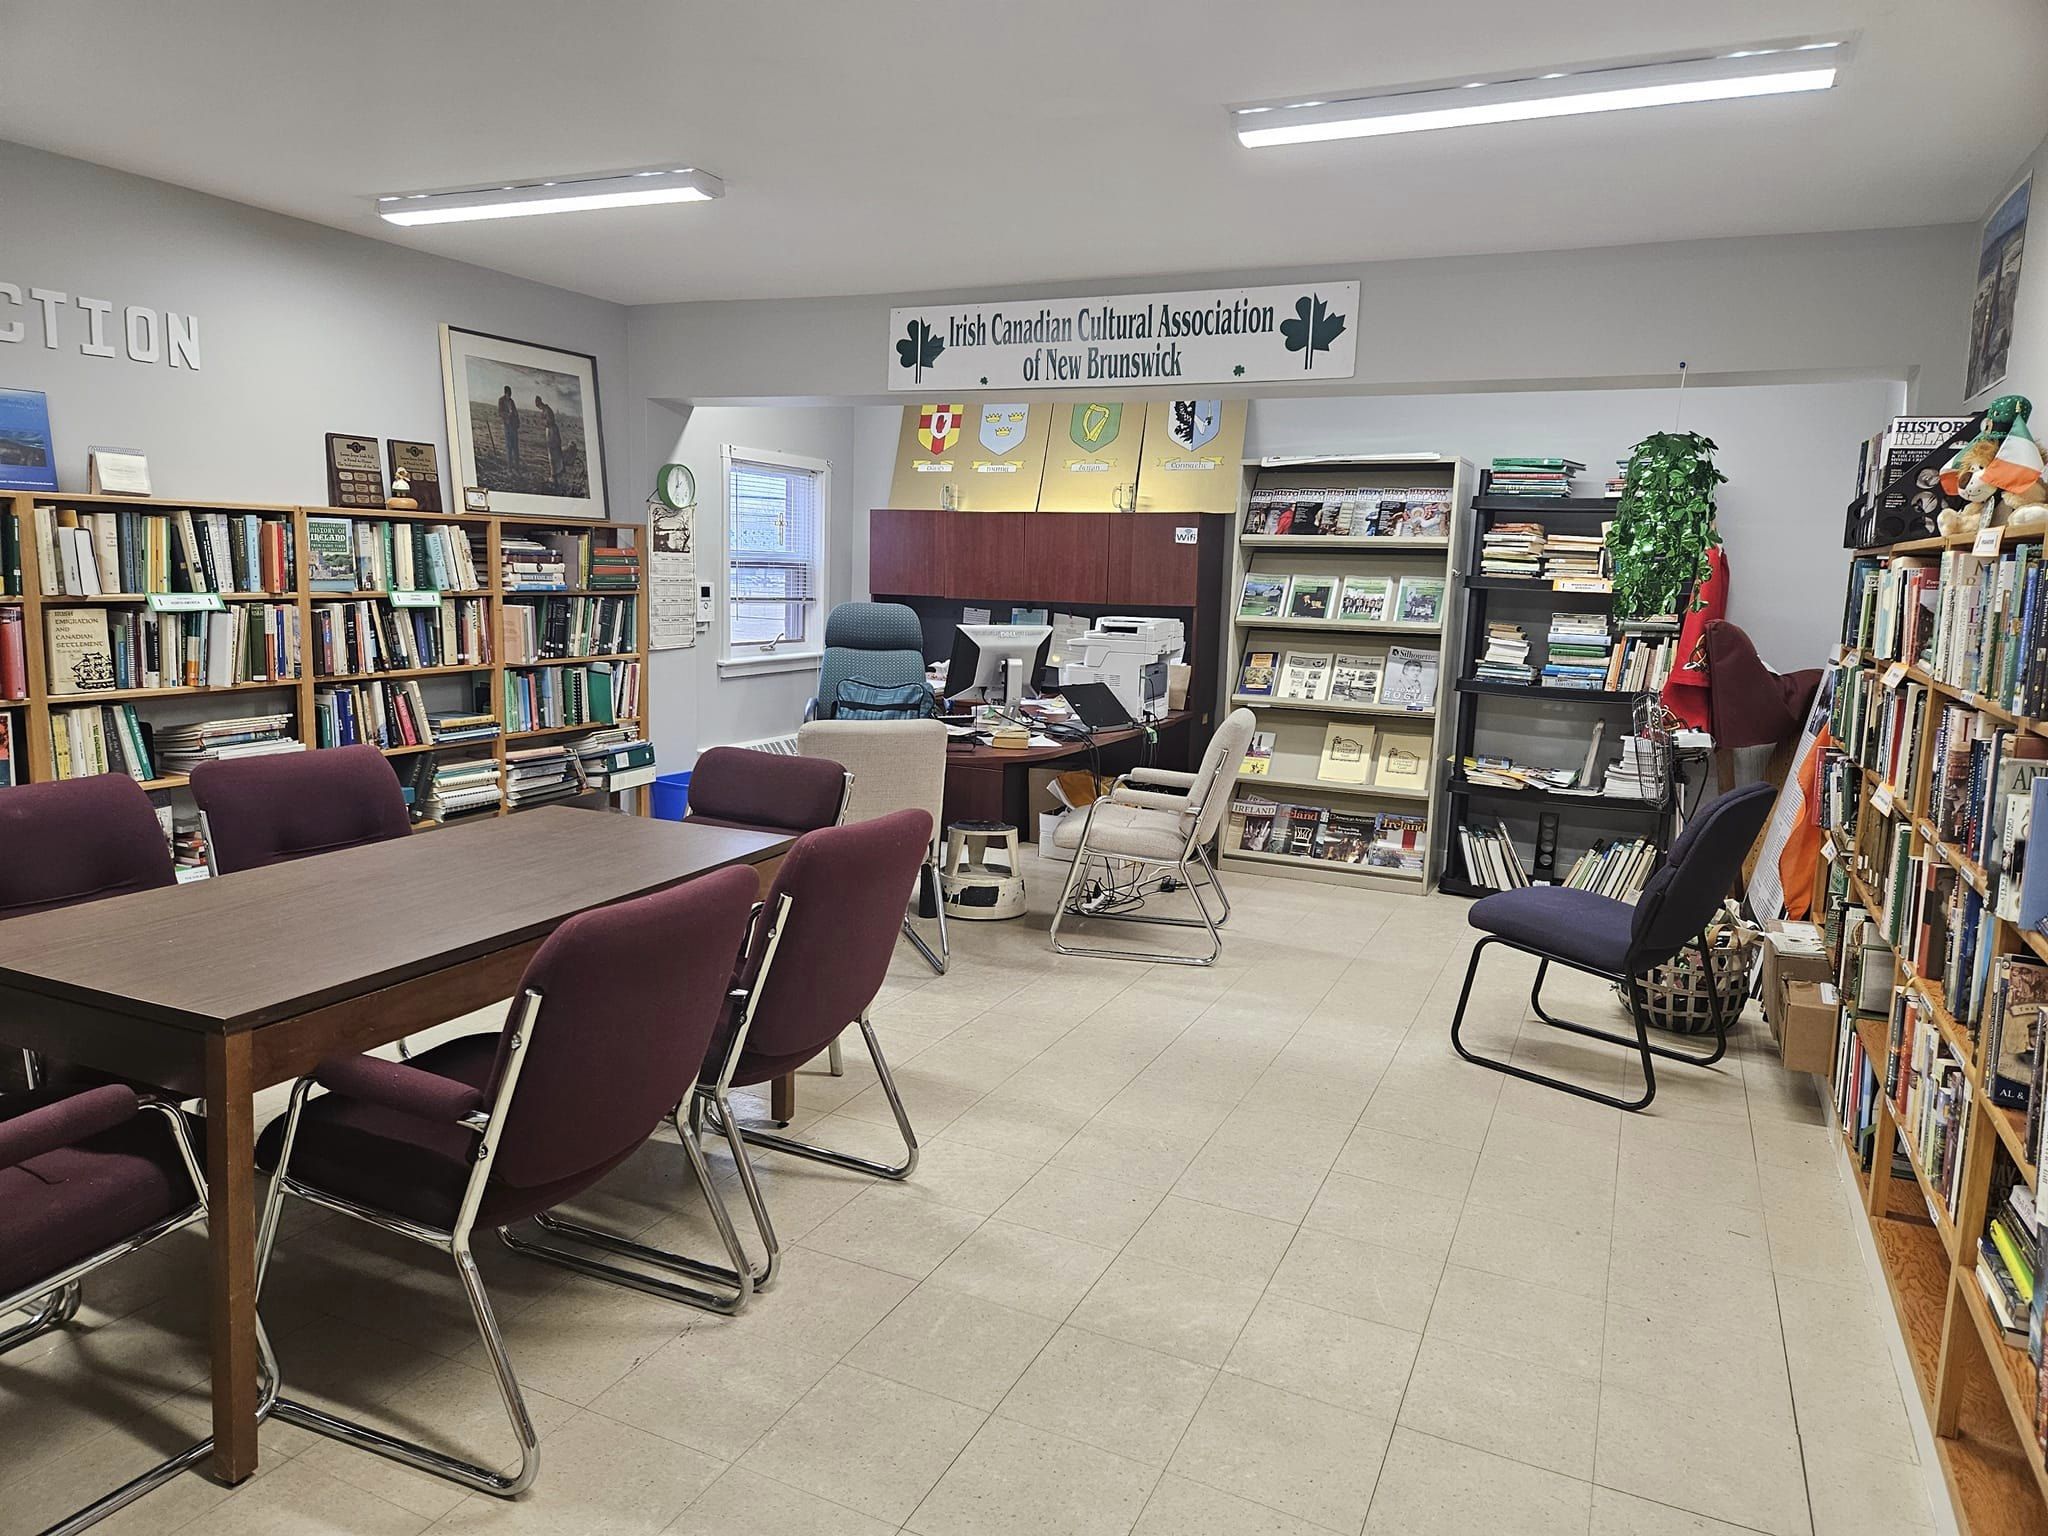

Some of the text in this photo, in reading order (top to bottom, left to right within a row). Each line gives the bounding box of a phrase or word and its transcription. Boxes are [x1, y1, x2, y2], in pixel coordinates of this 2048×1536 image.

[0, 282, 200, 370] CTION
[949, 302, 1274, 347] Irish Canadian Cultural Association
[1022, 342, 1182, 382] of New Brunswick
[1896, 421, 1969, 433] HISTOR
[1409, 488, 1448, 496] HISTORY
[310, 533, 346, 542] IRELAND
[1176, 533, 1196, 542] Wifi
[1000, 631, 1017, 639] DELL
[1400, 650, 1435, 661] Silhouette
[1383, 690, 1431, 701] ROGUE
[1233, 804, 1276, 816] IRELAND
[1279, 810, 1318, 821] Ireland
[1383, 819, 1426, 832] Ireland
